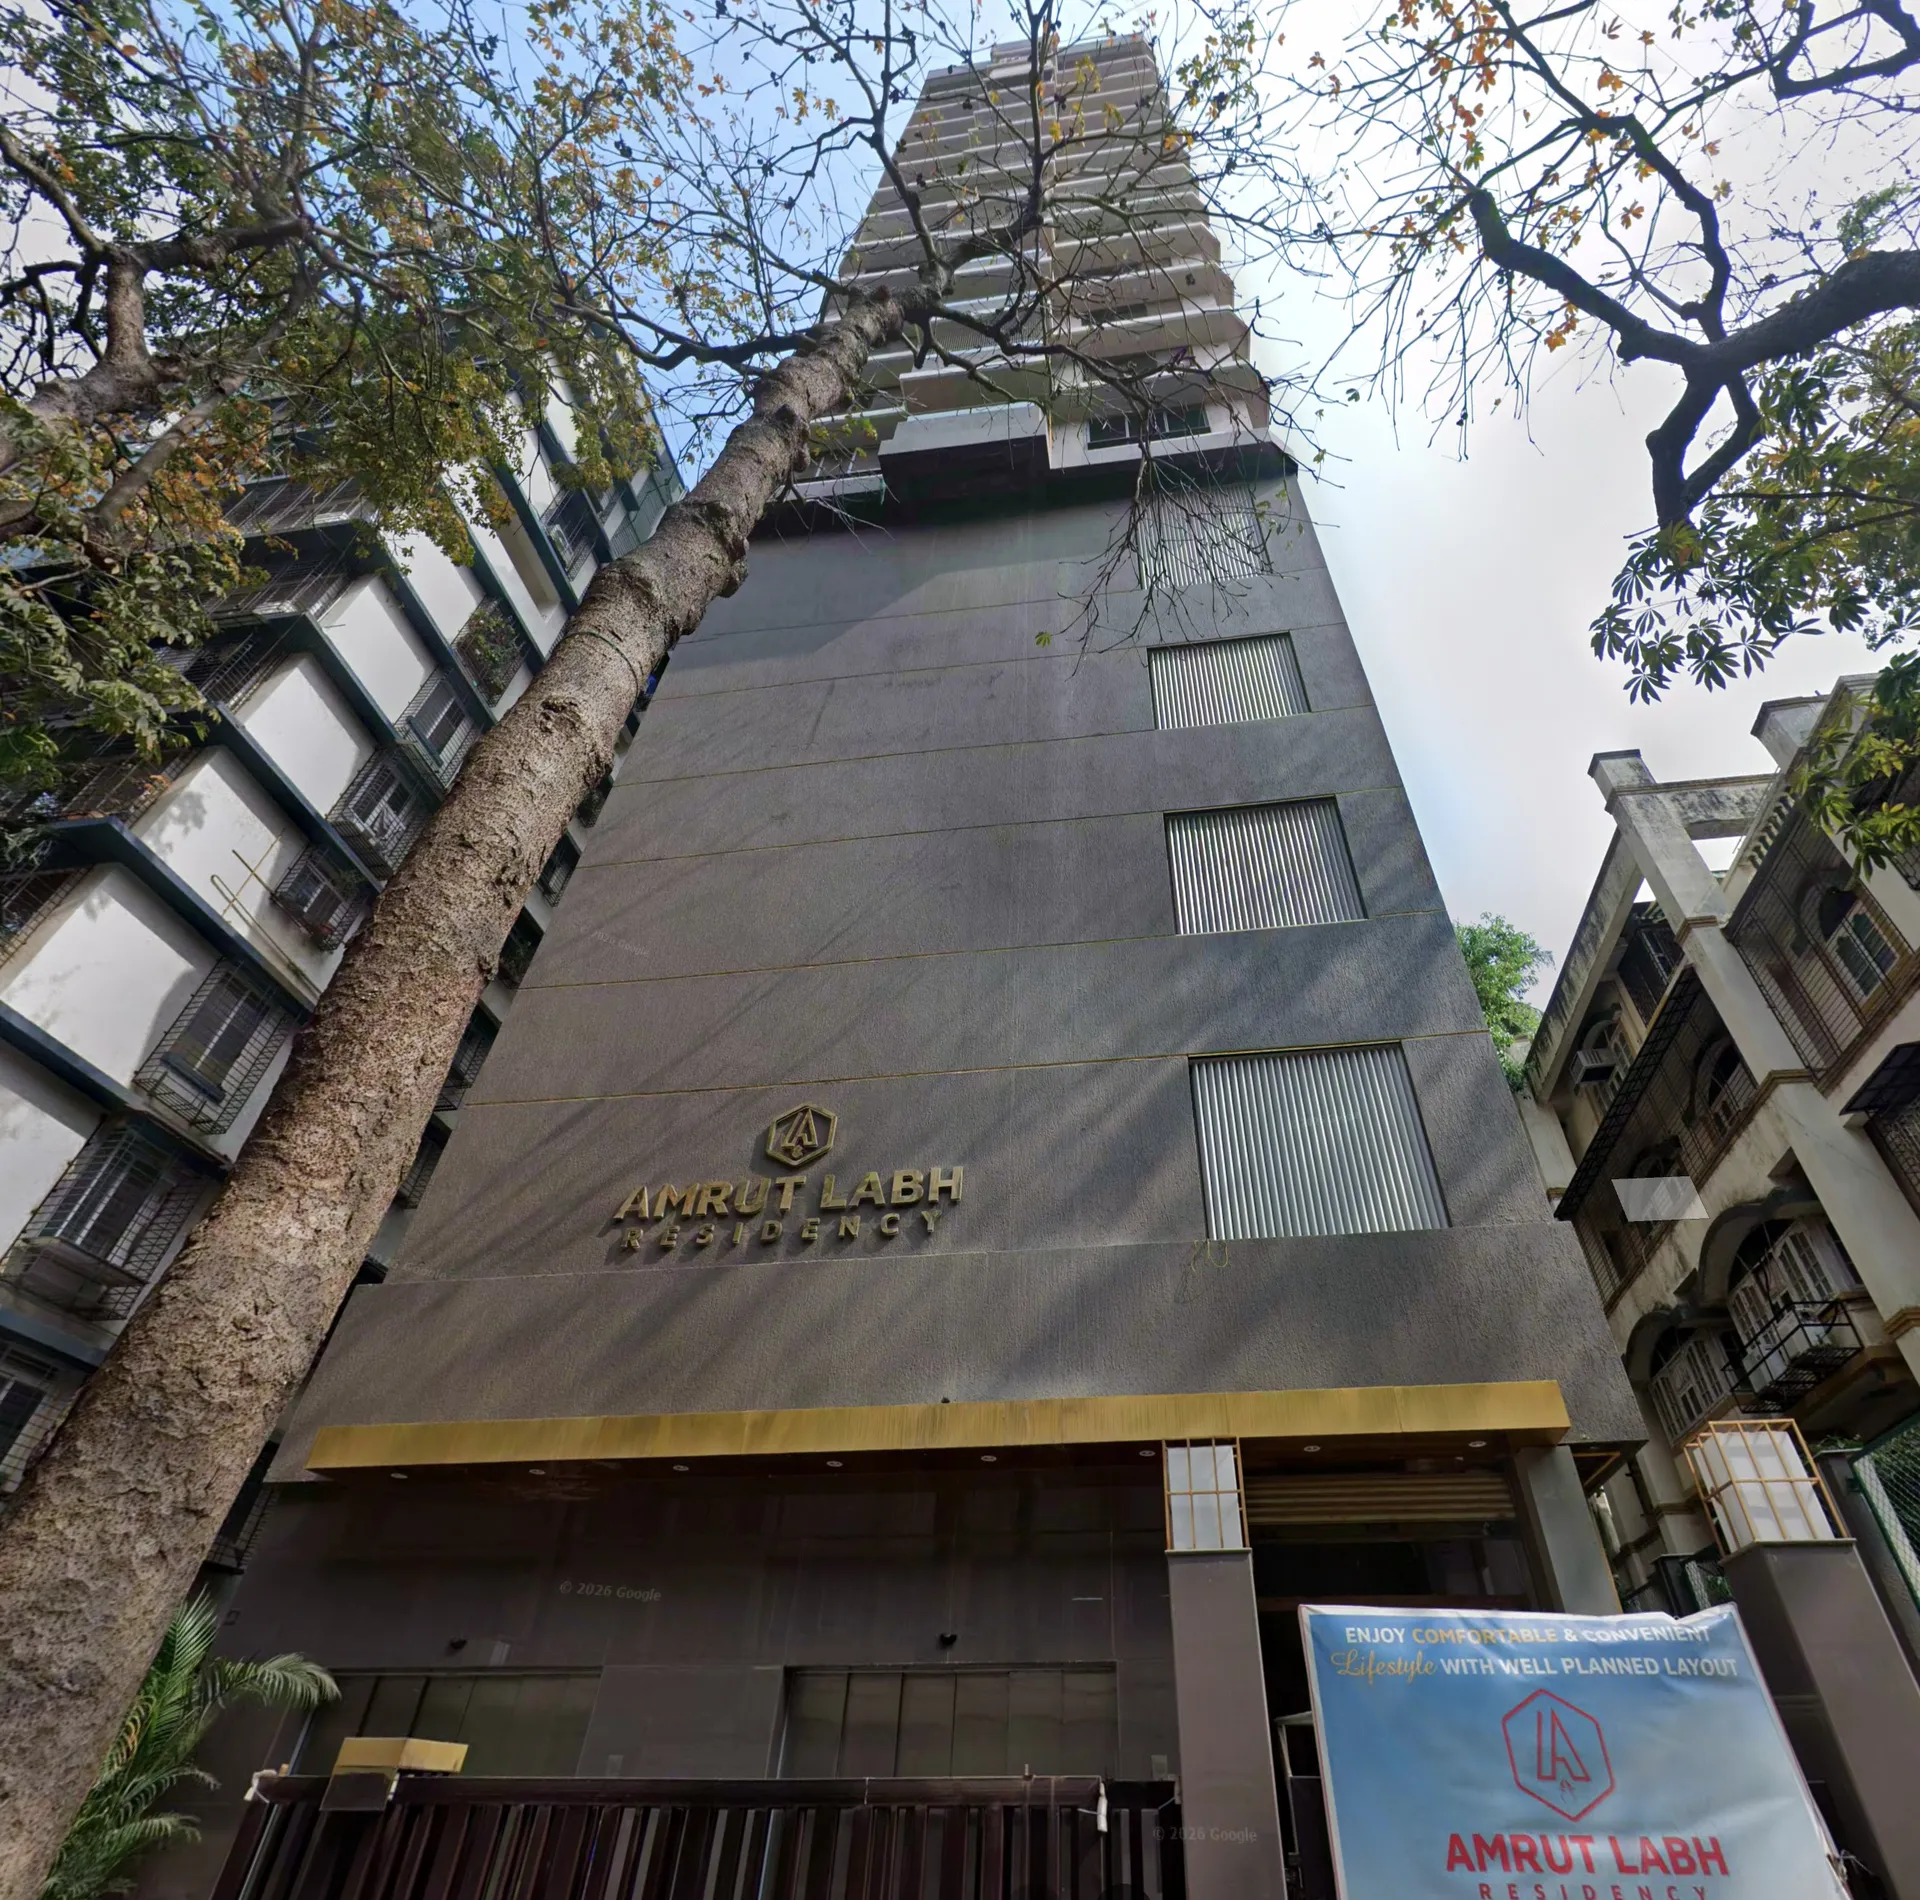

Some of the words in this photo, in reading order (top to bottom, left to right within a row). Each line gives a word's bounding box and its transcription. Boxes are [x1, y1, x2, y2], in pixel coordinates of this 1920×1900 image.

[614, 1175, 807, 1222] AMRUT
[820, 1166, 964, 1210] LABH
[621, 1210, 942, 1250] RESIDENCY
[1345, 1627, 1405, 1644] ENJOY
[1412, 1627, 1559, 1645] COMFORTABLE
[1564, 1628, 1578, 1642] &
[1582, 1625, 1711, 1643] CONVENIENT
[1330, 1649, 1437, 1686] Lifestyle
[1440, 1657, 1495, 1675] WITH
[1498, 1657, 1558, 1676] WELL
[1561, 1657, 1660, 1676] PLANNED
[1664, 1658, 1739, 1677] LAYOUT
[1446, 1833, 1597, 1875] AMRUT
[1608, 1835, 1730, 1877] LABH
[1479, 1883, 1706, 1900] RESIDENCY
